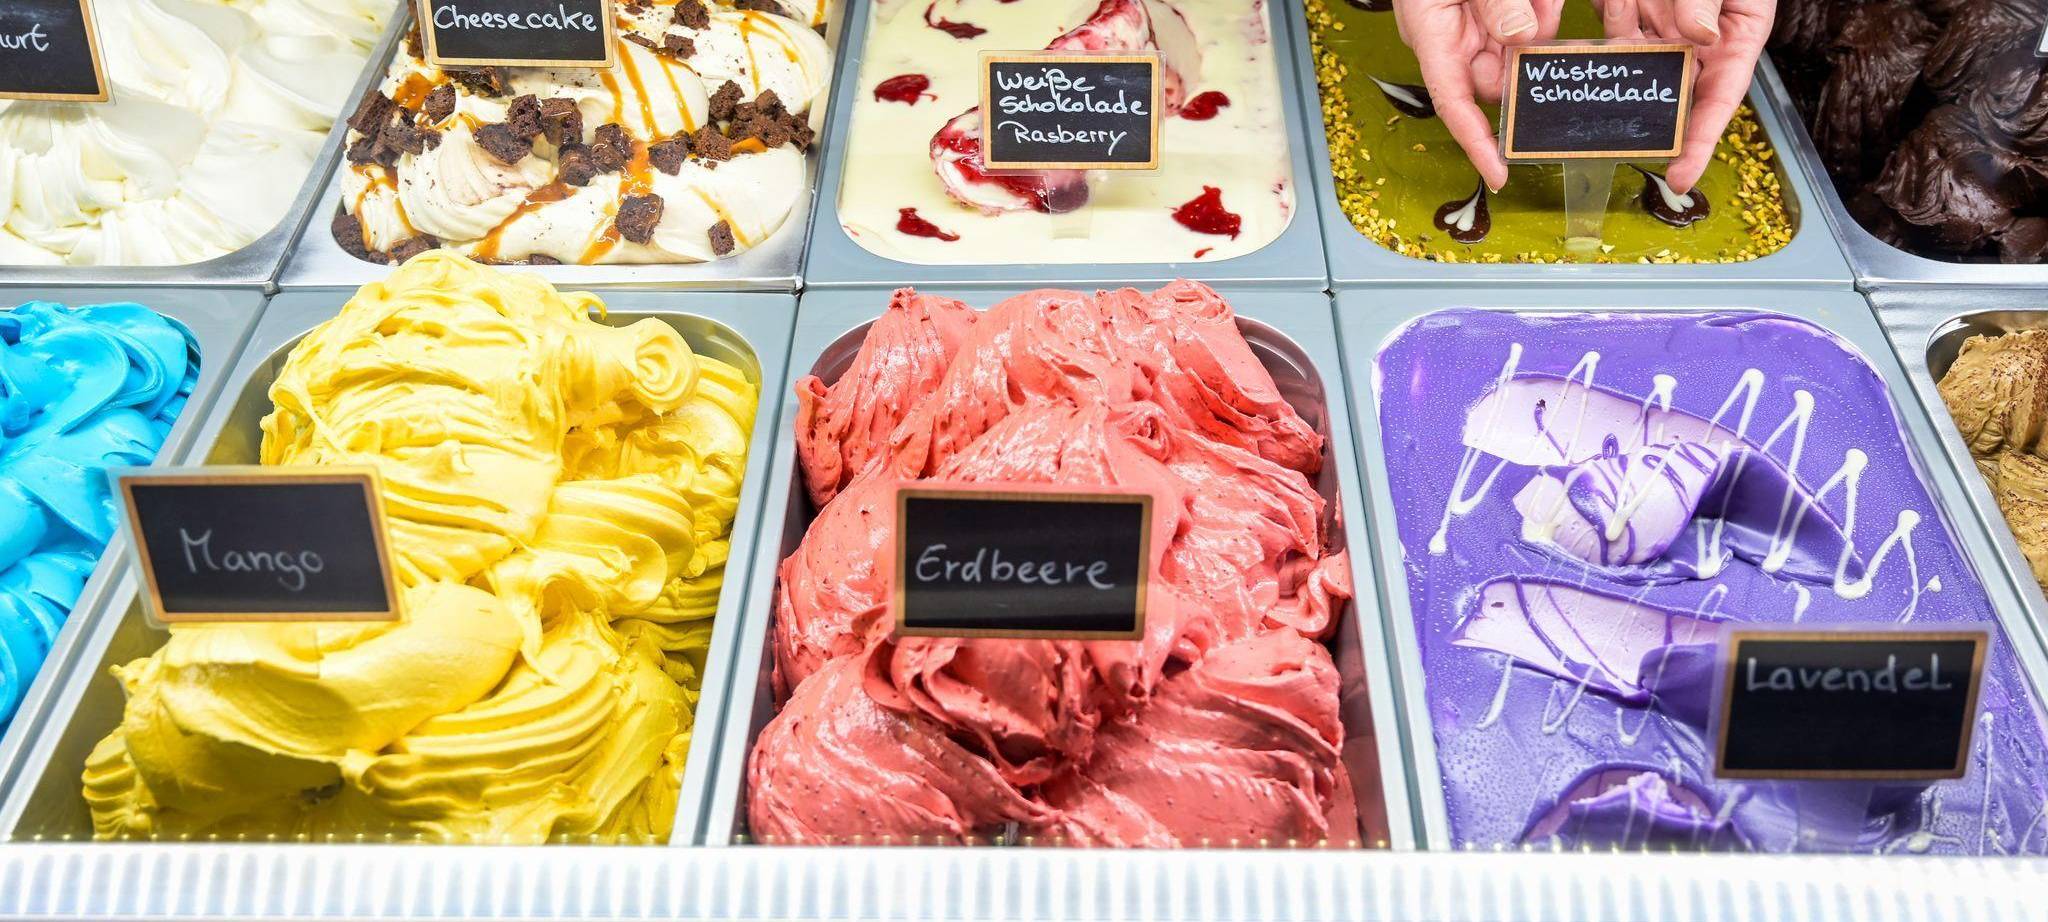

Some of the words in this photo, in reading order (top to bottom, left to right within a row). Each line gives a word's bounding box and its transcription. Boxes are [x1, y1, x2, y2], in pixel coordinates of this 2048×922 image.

[433, 4, 597, 32] Cheesecake
[996, 68, 1095, 100] Weiße
[1525, 59, 1643, 82] Wüsten-
[998, 120, 1127, 156] Rasberry
[180, 528, 323, 591] Mango
[916, 544, 1115, 590] Erdbeere
